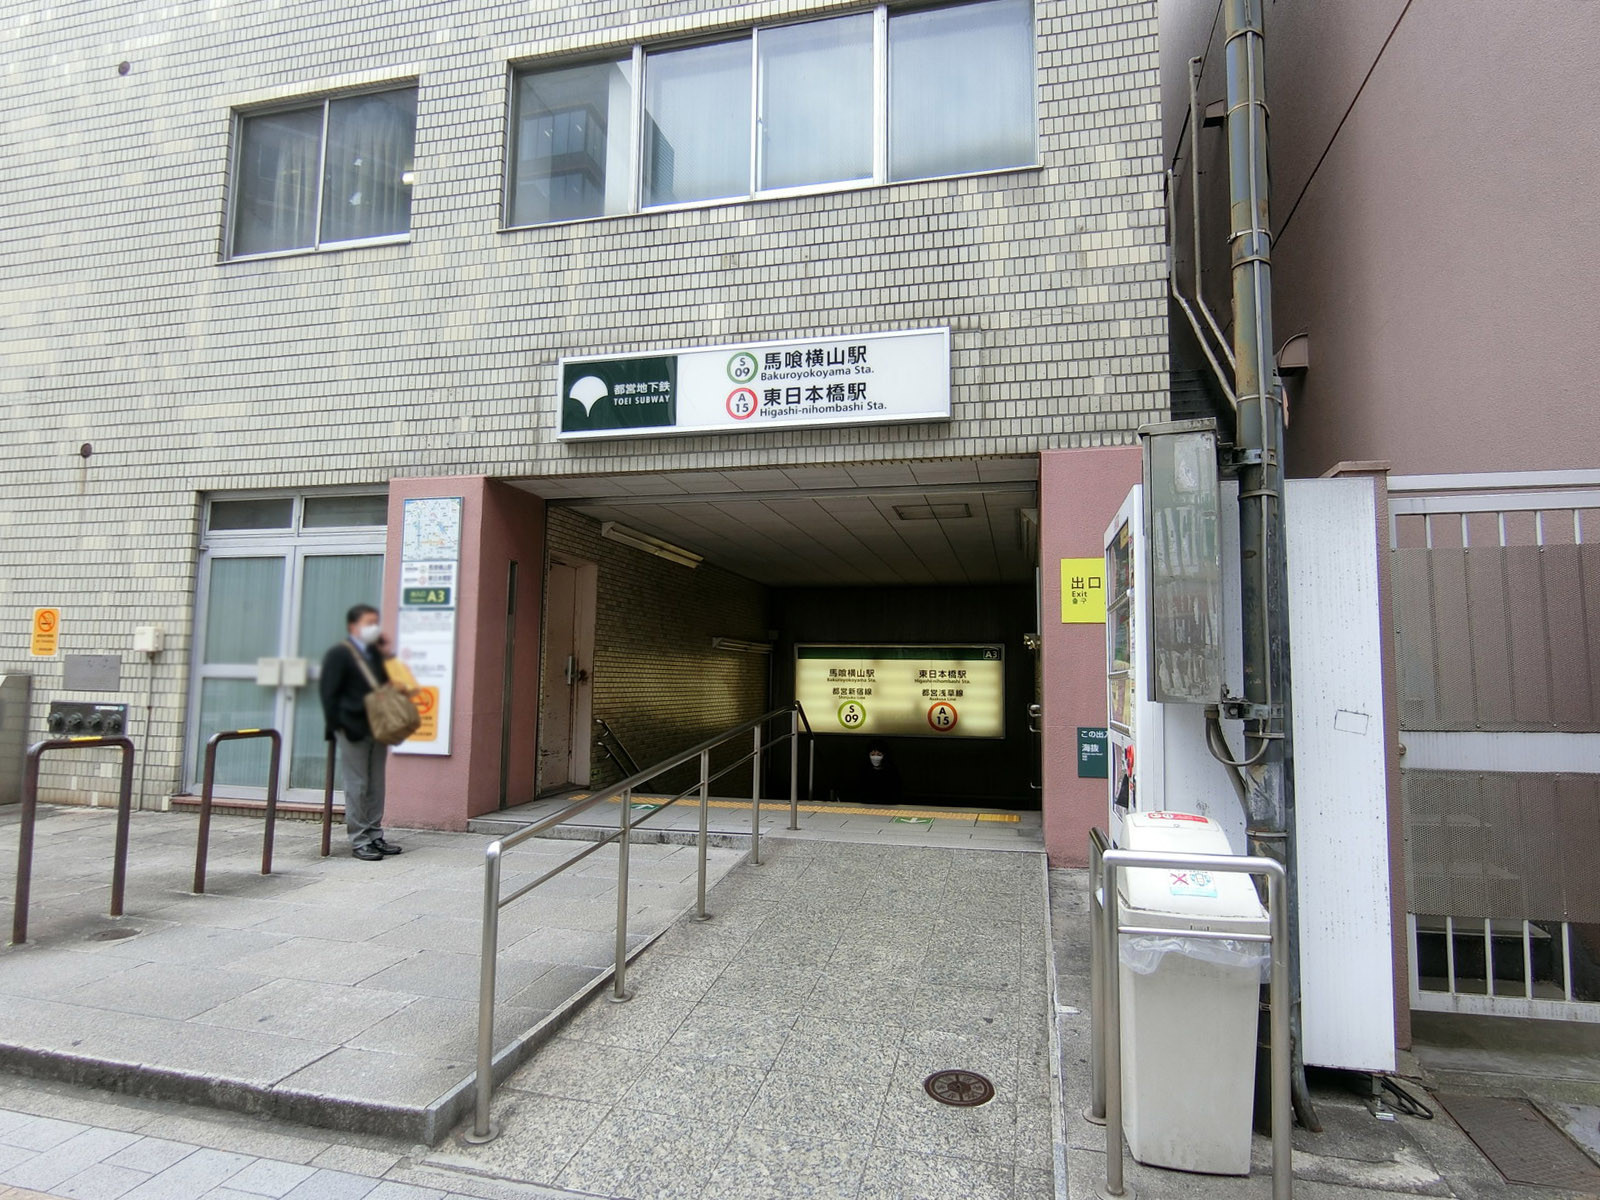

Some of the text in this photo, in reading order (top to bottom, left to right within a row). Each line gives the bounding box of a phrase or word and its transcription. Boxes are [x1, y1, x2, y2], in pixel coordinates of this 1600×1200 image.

[739, 357, 746, 367] S
[763, 345, 868, 371] 馬喰横山駅
[734, 367, 751, 378] 09
[760, 365, 875, 382] Bakuroyokoyama Sta.
[613, 381, 671, 395] 都営地下鉄
[737, 393, 747, 402] A
[763, 382, 867, 407] 東日本橋駅
[613, 394, 671, 406] TOEI SUBWAY
[735, 402, 750, 413] 15
[760, 401, 888, 419] Higashi-nihombashi Sta.
[1071, 576, 1101, 589] 出口
[427, 590, 445, 603] A3
[1071, 590, 1088, 598] Exit
[985, 650, 998, 658] A3
[829, 668, 875, 678] 馬喰横山駅
[918, 669, 967, 679] 東日本橋駅
[849, 704, 855, 713] S
[938, 706, 947, 715] A
[844, 713, 859, 723] 09
[936, 716, 950, 726] 15
